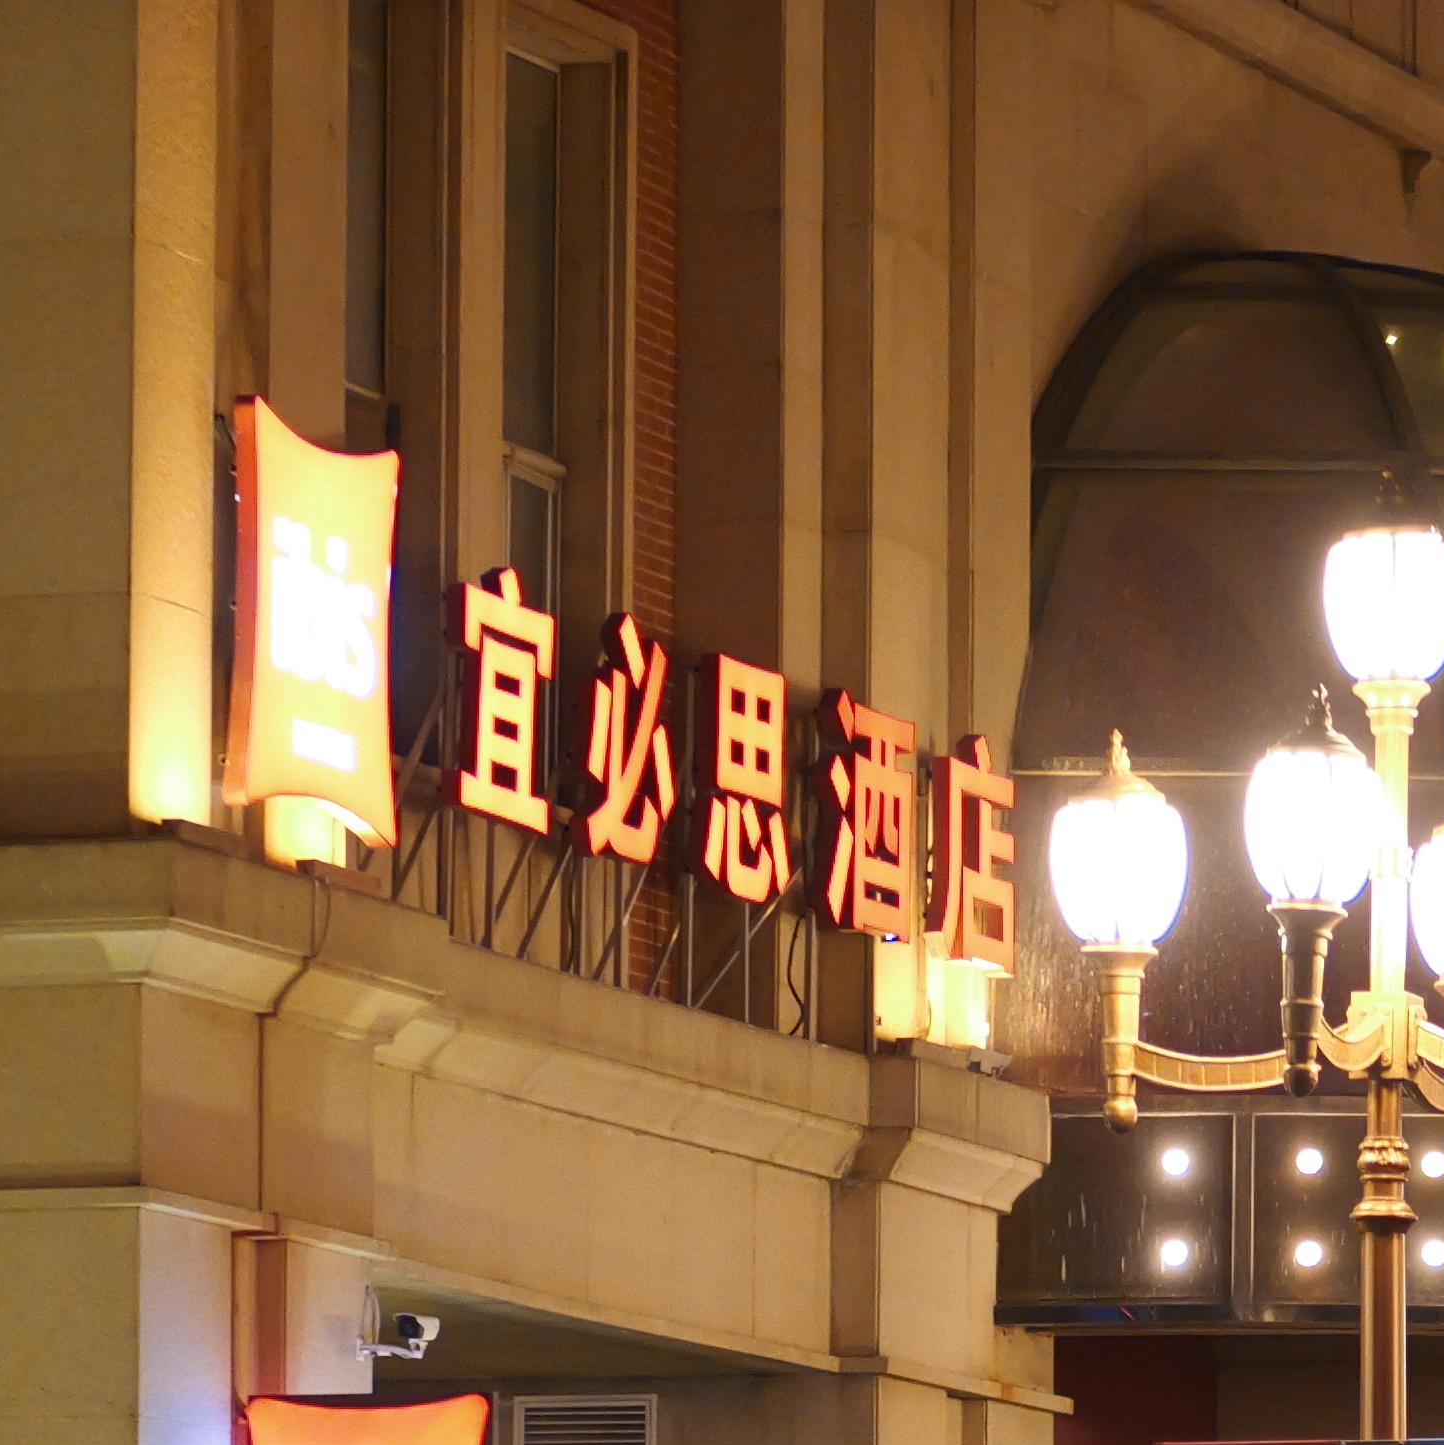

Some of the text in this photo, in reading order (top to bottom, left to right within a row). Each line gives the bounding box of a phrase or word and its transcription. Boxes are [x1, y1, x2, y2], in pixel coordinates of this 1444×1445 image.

[450, 566, 1017, 978] 宜必思酒店
